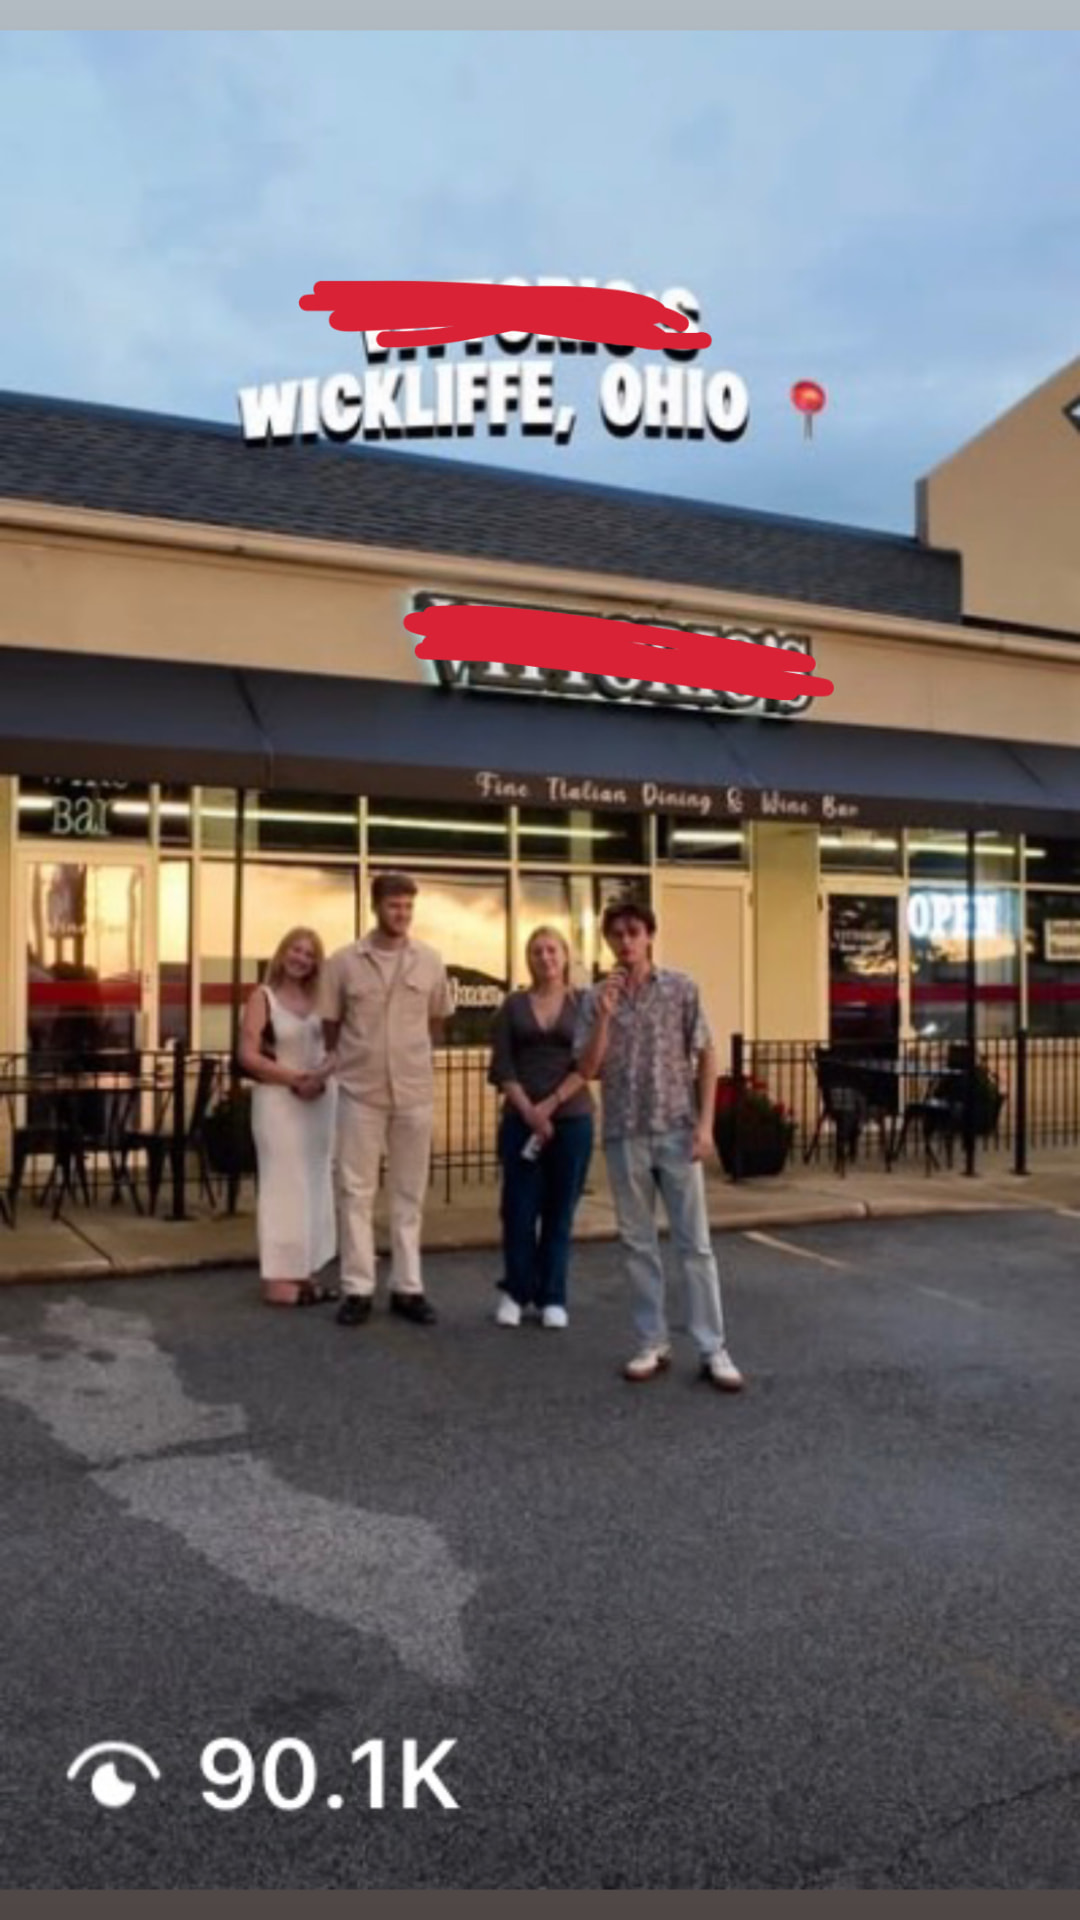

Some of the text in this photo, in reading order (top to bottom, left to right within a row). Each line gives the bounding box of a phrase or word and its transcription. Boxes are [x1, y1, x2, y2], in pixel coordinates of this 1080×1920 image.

[476, 771, 859, 819] Fine Italian Dining & Wine Bar
[908, 892, 998, 939] OPEN
